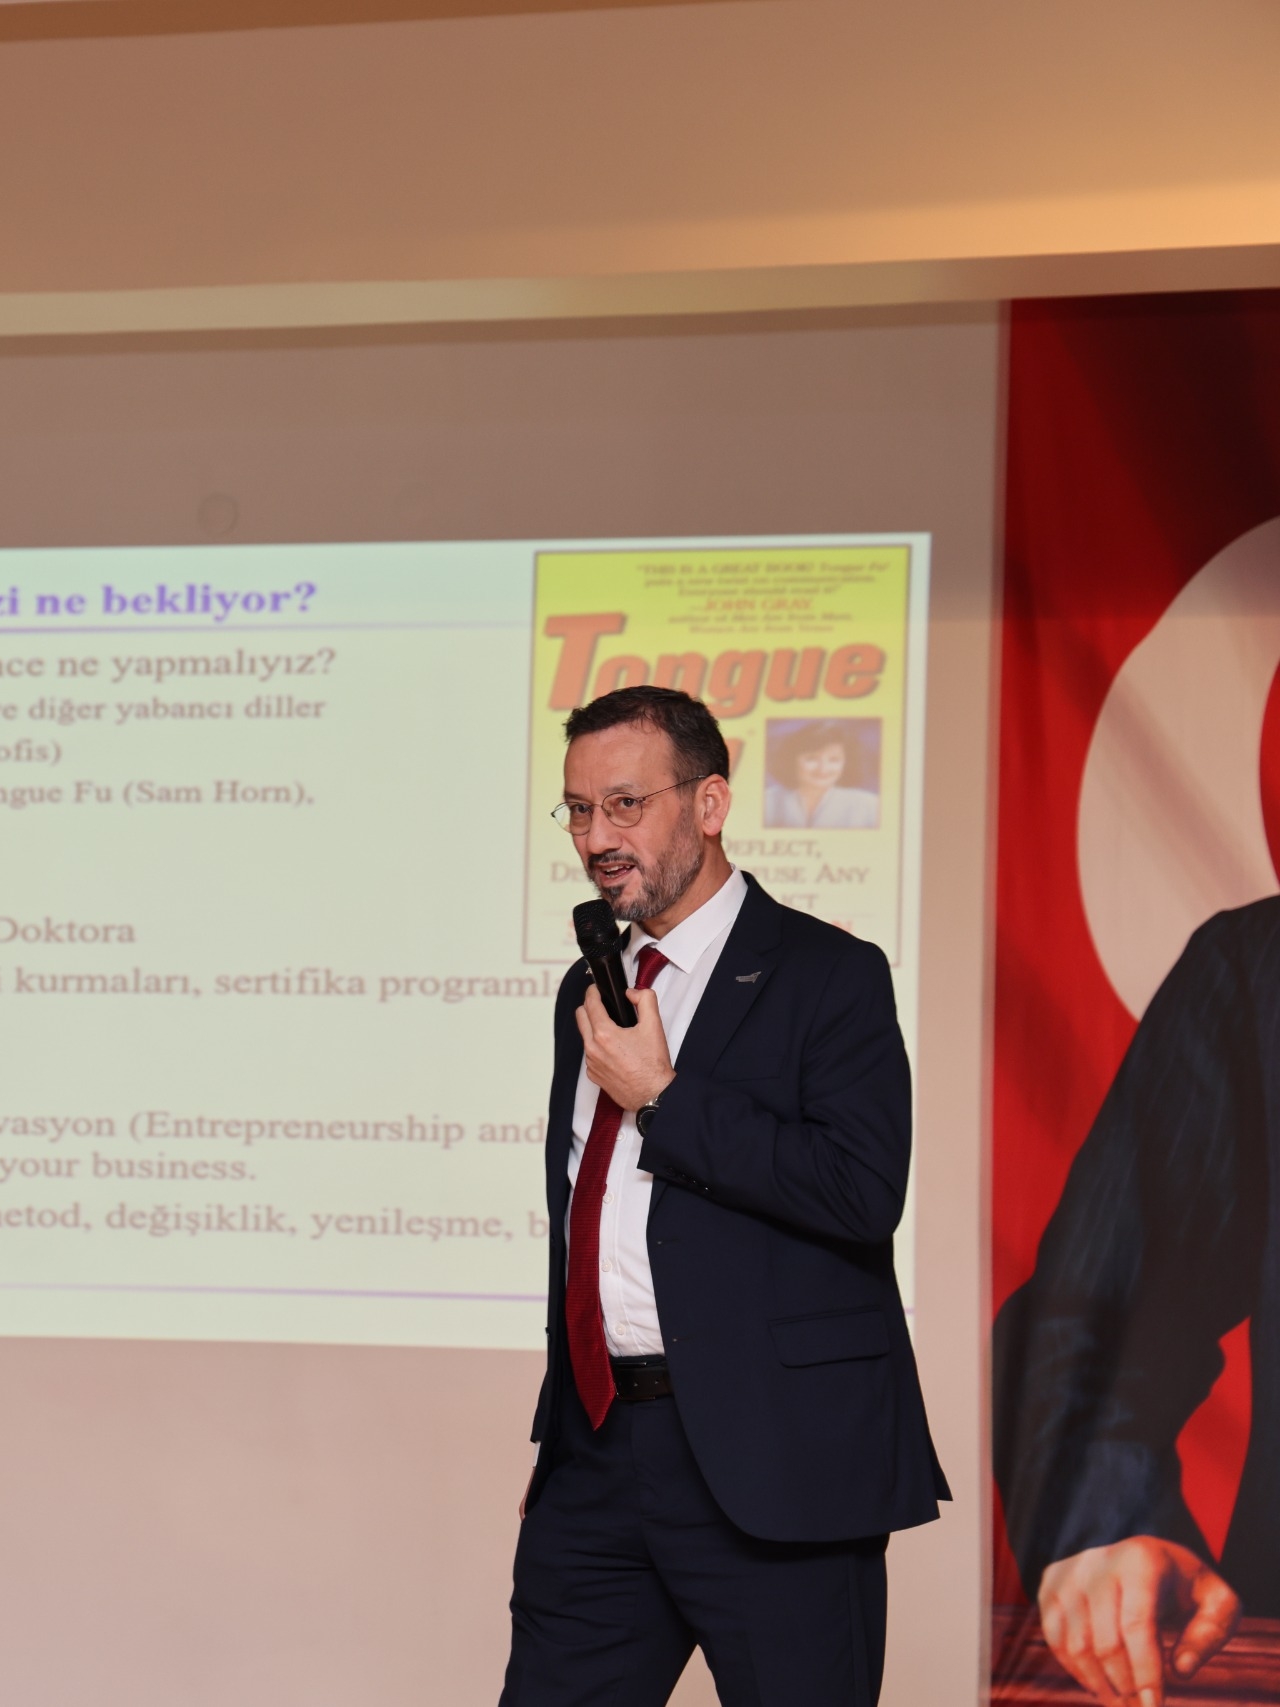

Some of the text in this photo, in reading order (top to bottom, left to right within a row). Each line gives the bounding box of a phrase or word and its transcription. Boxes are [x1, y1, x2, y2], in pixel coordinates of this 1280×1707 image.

[36, 594, 86, 615] ne
[102, 582, 317, 622] bekliyor?
[58, 657, 99, 677] ne
[111, 647, 336, 684] yapmalıyız?
[543, 611, 887, 719] Tongue
[28, 697, 107, 726] diğer
[115, 696, 234, 725] yabancı
[244, 695, 326, 719] diller
[74, 780, 113, 804] Fu
[122, 780, 203, 806] (Sam
[213, 780, 314, 807] Horn),
[14, 966, 202, 997] kurmaları,
[215, 967, 367, 996] sertifika
[378, 970, 562, 1004] programl
[129, 1110, 466, 1150] (Entrepreneurship
[478, 1116, 545, 1144] and
[92, 1151, 256, 1180] business.
[105, 1202, 298, 1238] değişiklik,
[310, 1207, 514, 1242] yenileşme,
[527, 1209, 549, 1239] b
